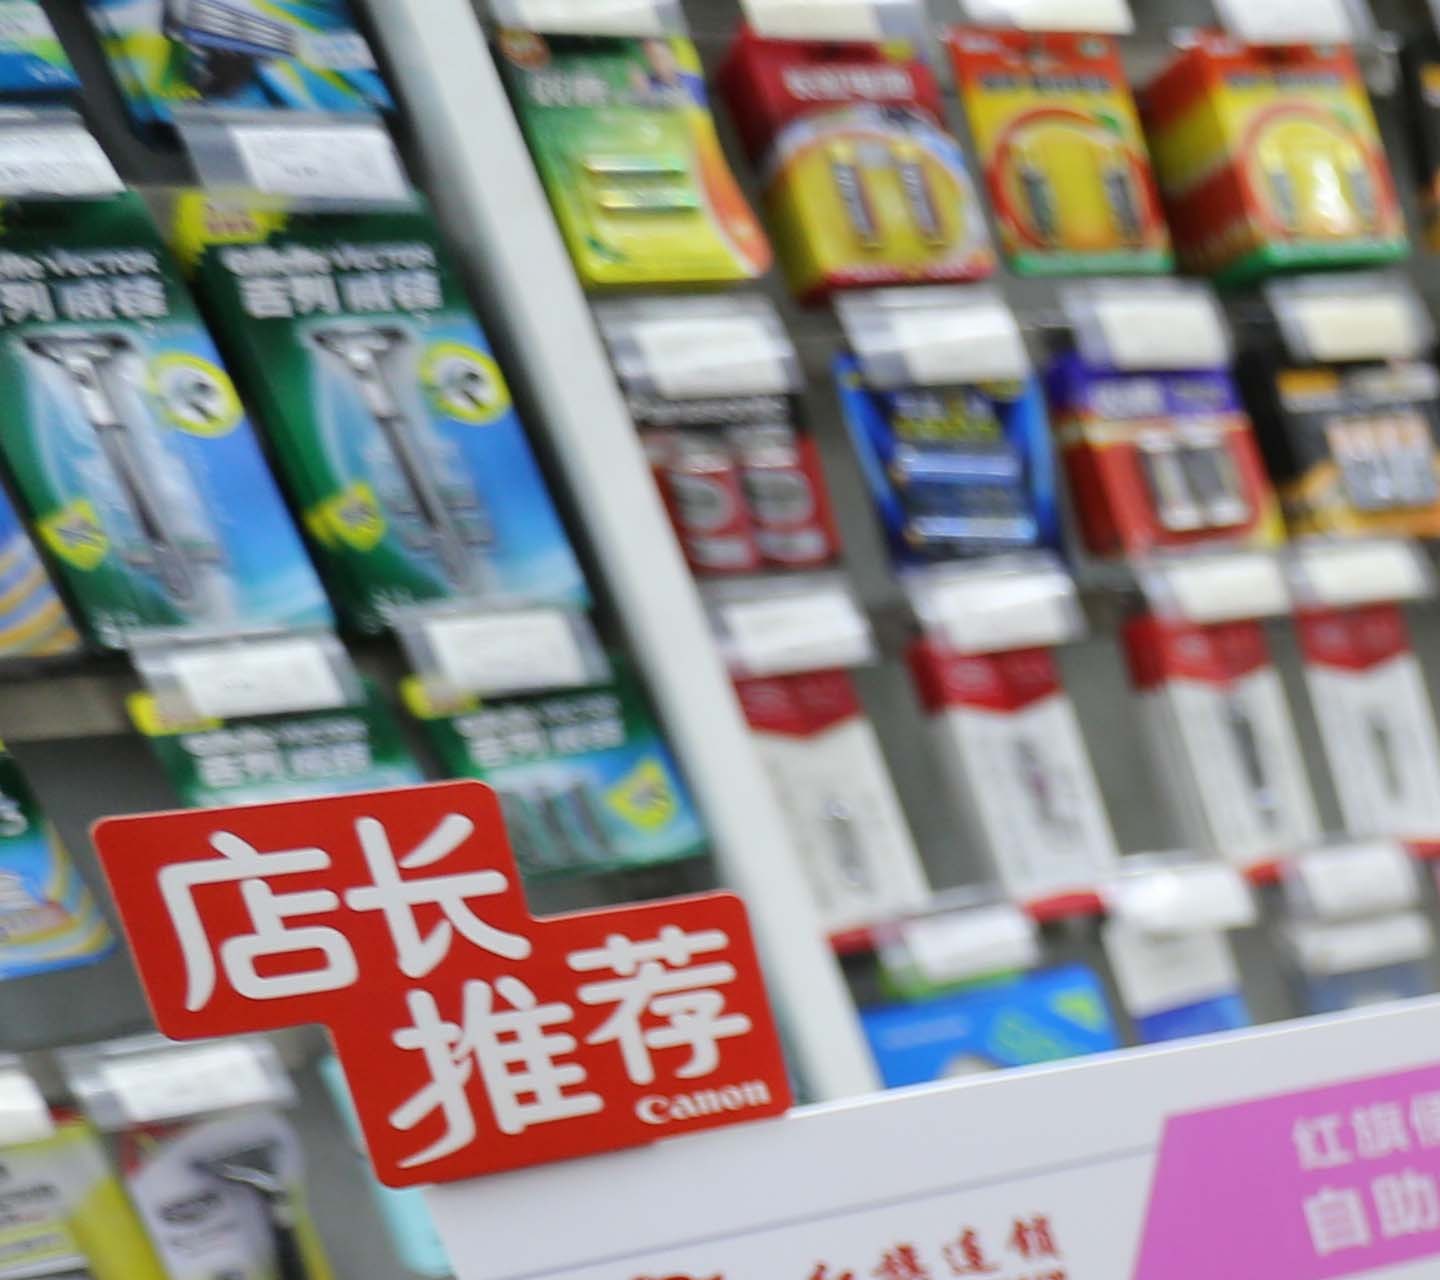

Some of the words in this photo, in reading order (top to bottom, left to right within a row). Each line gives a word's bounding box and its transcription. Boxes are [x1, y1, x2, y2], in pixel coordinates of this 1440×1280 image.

[157, 812, 532, 1012] 店长
[388, 924, 753, 1170] 推荐
[634, 1079, 771, 1125] Canon
